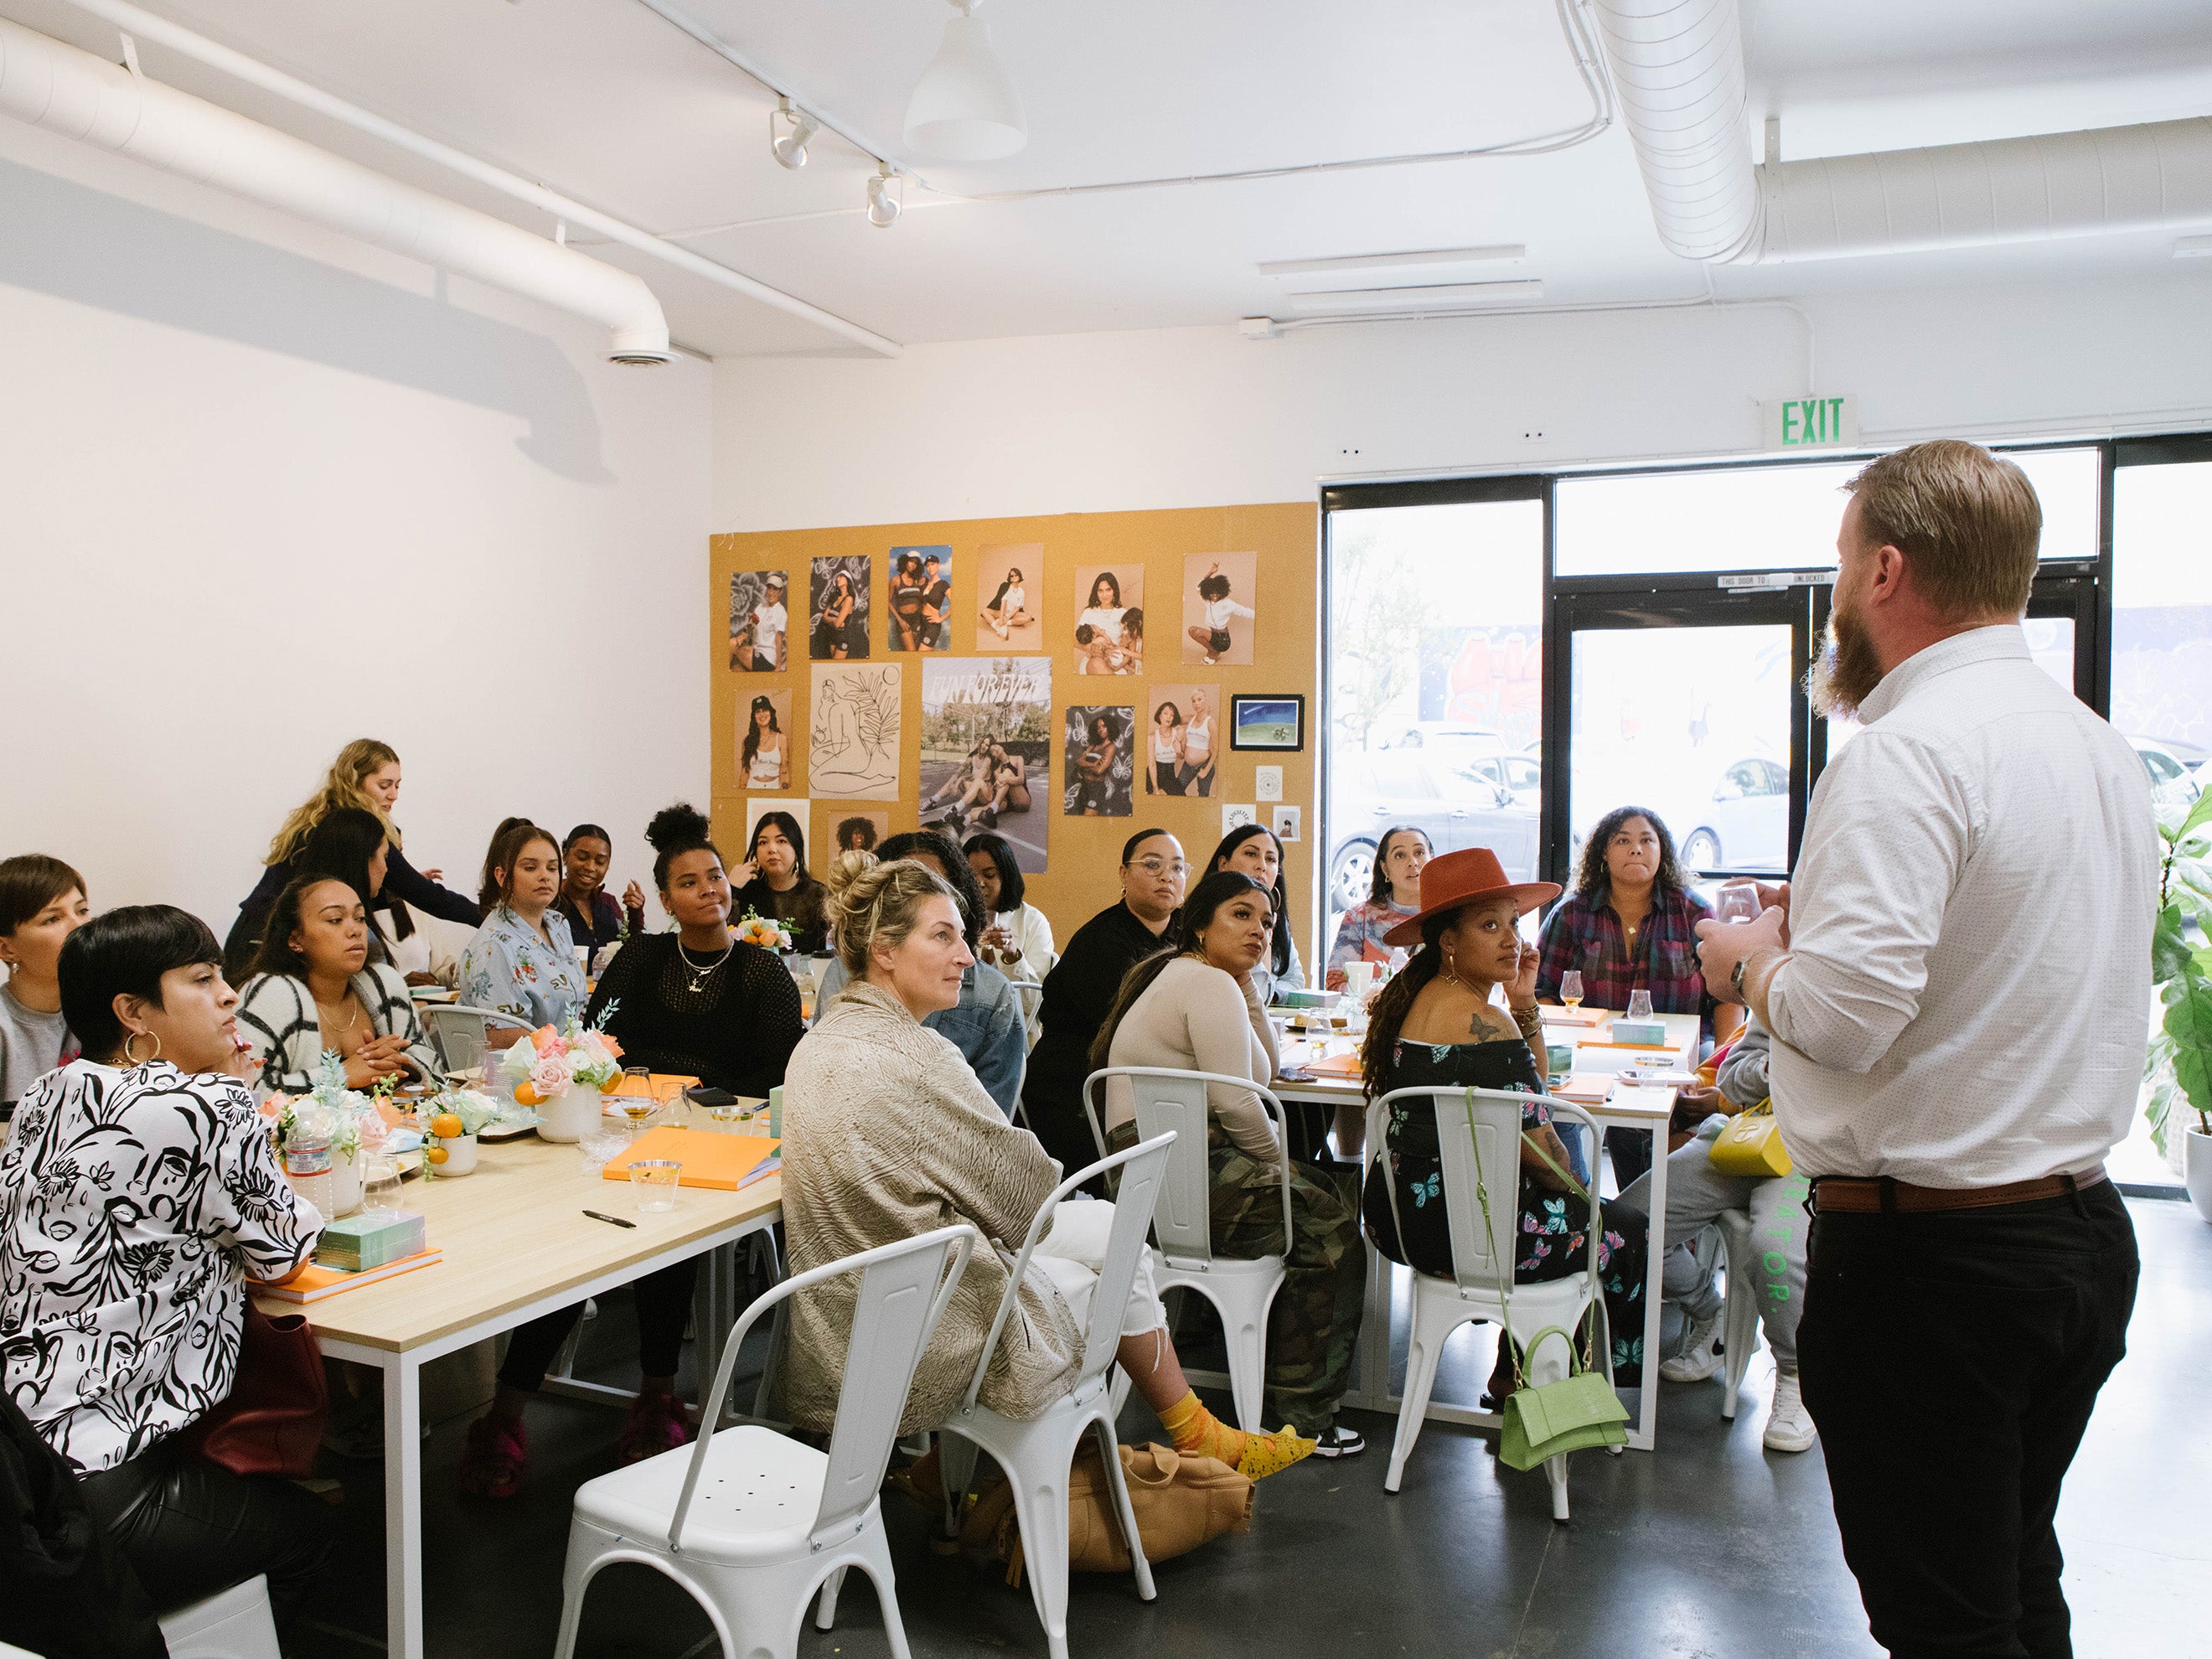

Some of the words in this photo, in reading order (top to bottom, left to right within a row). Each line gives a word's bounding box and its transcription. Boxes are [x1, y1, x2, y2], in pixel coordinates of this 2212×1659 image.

[1783, 398, 1844, 445] EXIT
[1738, 576, 1754, 585] DOOR
[1758, 576, 1765, 584] TO
[929, 674, 966, 703] FUN
[962, 674, 1042, 703] FOREVER
